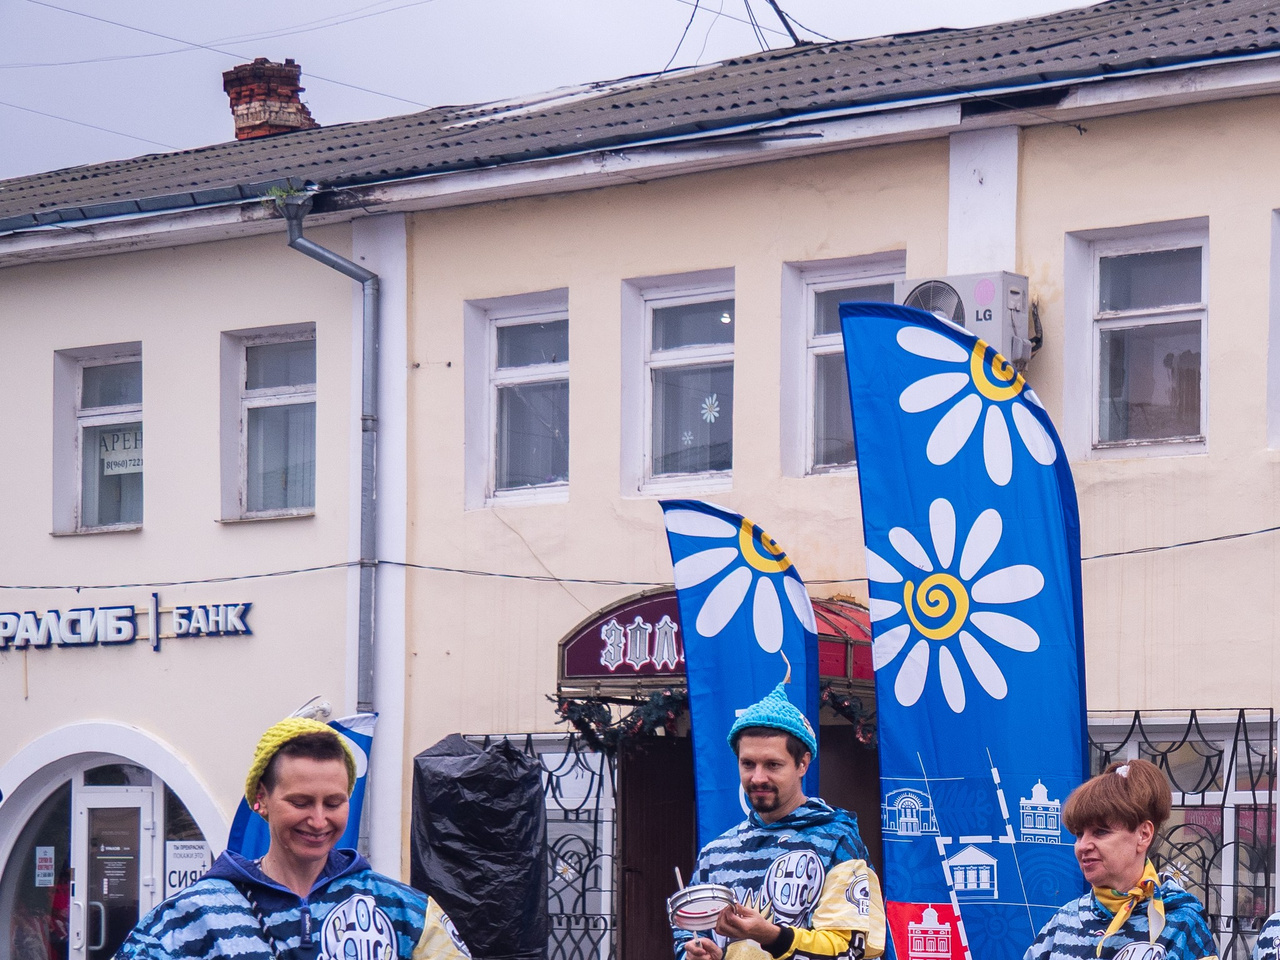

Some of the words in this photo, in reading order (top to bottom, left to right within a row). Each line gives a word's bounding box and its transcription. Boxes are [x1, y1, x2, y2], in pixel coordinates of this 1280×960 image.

[975, 308, 993, 322] LG
[99, 431, 143, 452] АРЕН
[0, 604, 136, 650] РАЛСИБ
[172, 602, 253, 638] БАНК
[600, 614, 685, 671] ЗОЛ
[774, 853, 816, 881] BLOC
[332, 898, 385, 943] BLOC
